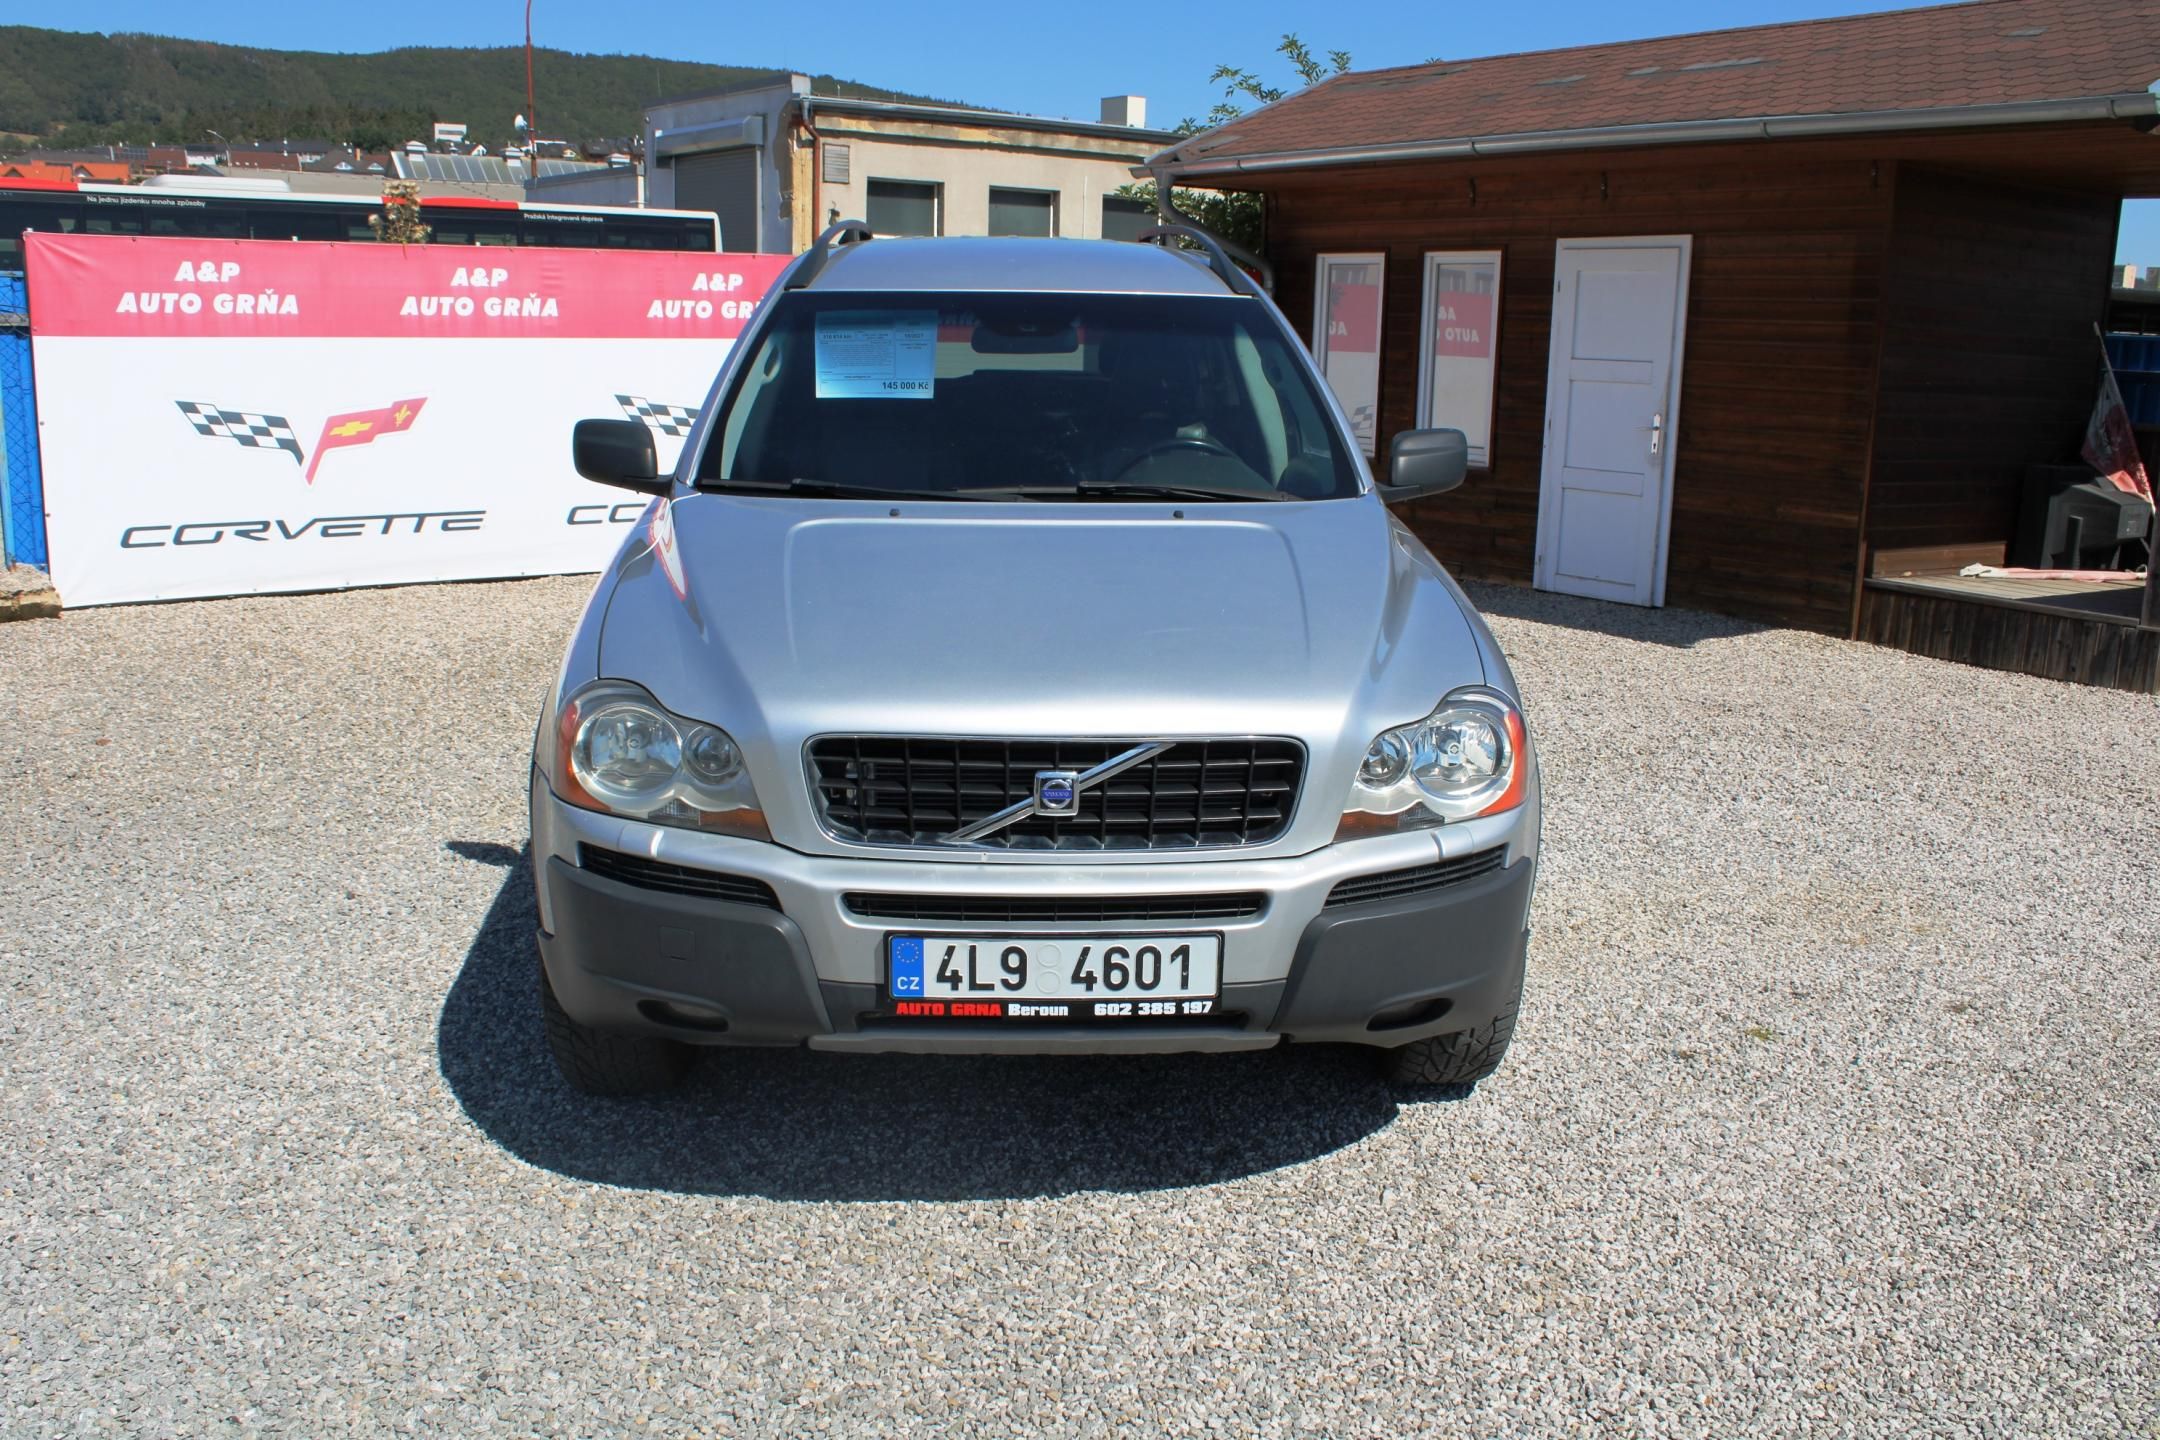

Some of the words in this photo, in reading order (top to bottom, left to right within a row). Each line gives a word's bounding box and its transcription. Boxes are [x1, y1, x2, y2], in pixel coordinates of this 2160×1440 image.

[174, 261, 240, 282] A&P
[450, 267, 508, 287] A&P
[692, 272, 744, 291] A&P
[115, 292, 203, 314] AUTO
[213, 288, 299, 315] GRŇA
[400, 296, 475, 316] AUTO
[483, 293, 559, 317] GRŇA
[646, 300, 713, 319] AUTO
[721, 297, 764, 319] GR
[882, 381, 898, 390] 145
[900, 381, 916, 390] 000
[918, 381, 929, 390] Kč
[120, 510, 487, 549] CORVETTE
[936, 944, 1029, 992] 4L9
[1071, 944, 1191, 992] 4601
[897, 976, 920, 990] CZ
[896, 1002, 944, 1016] AUTO
[1008, 1003, 1069, 1016] Beroun
[1094, 1002, 1132, 1016] 602
[1138, 1001, 1176, 1015] 385
[1181, 1000, 1213, 1014] 197
